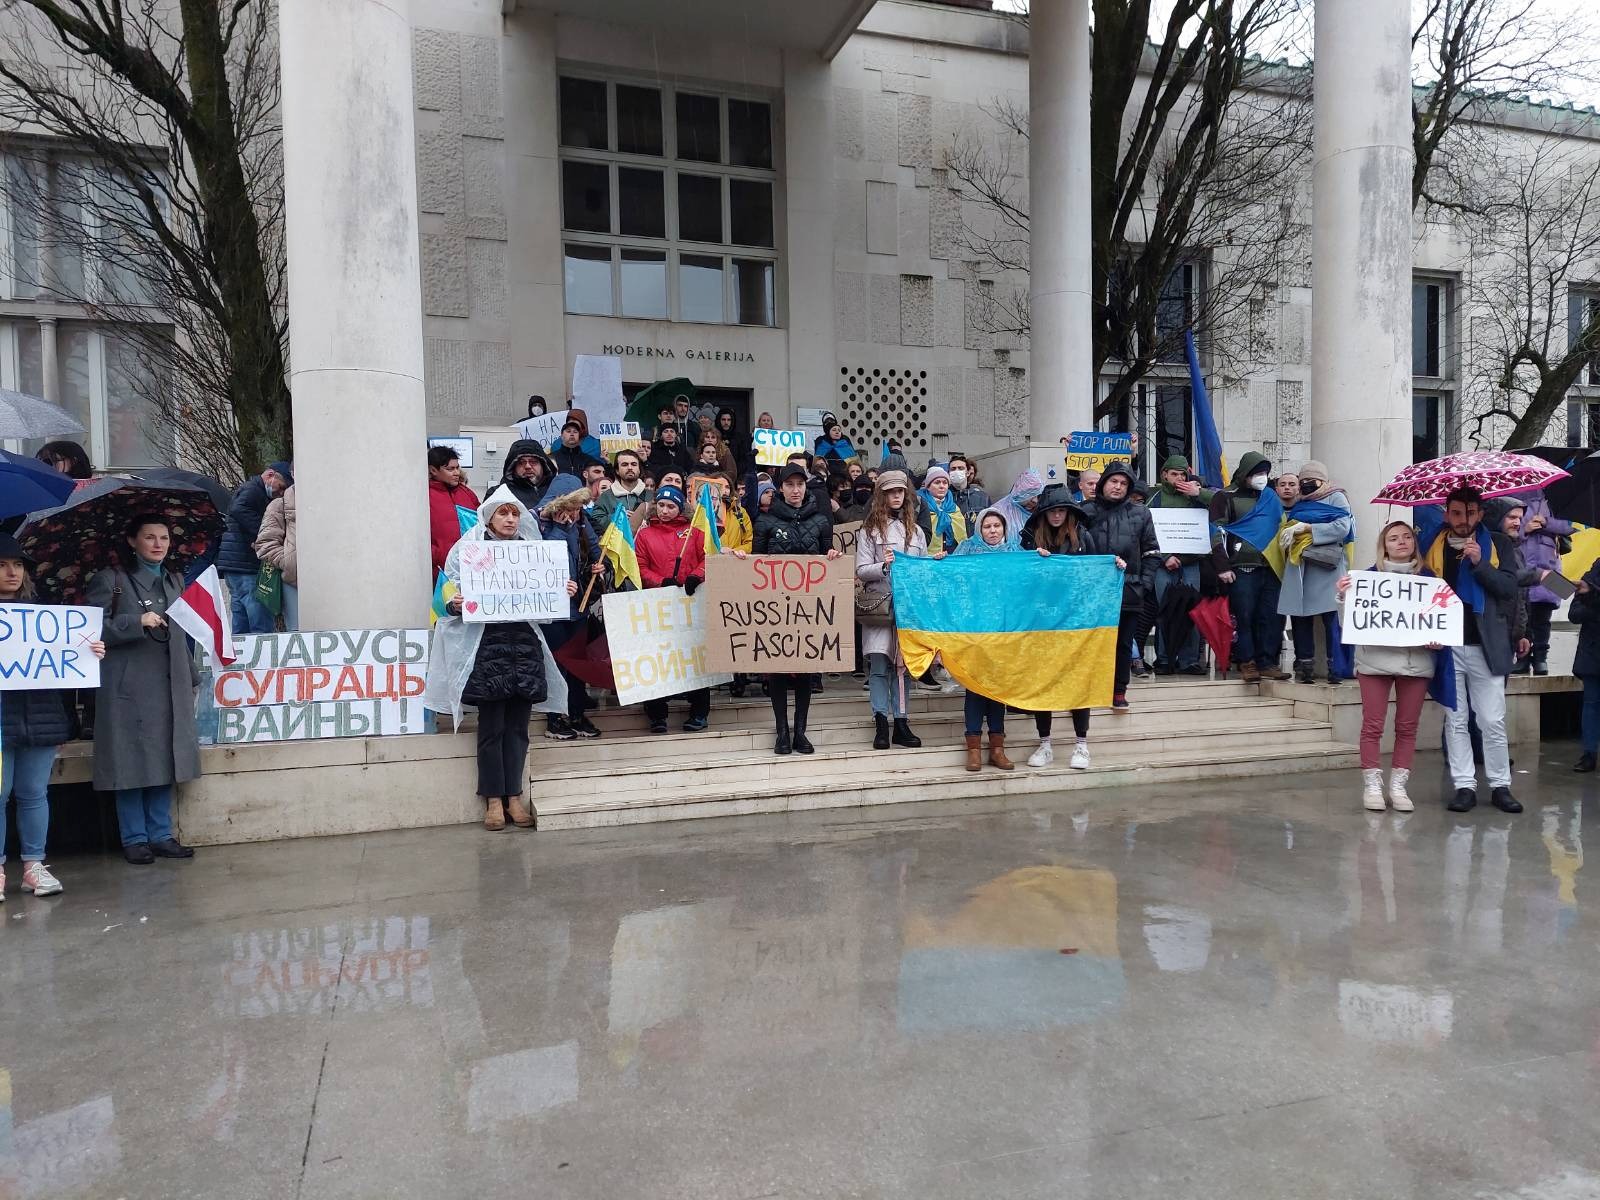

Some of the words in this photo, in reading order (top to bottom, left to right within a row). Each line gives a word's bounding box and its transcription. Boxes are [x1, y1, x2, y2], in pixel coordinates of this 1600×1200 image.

[602, 344, 675, 359] MODERNA
[685, 349, 755, 362] GALERIJA
[599, 423, 622, 435] SAVE
[754, 428, 805, 447] СТОП
[1070, 434, 1100, 449] STOP
[1102, 436, 1132, 451] PUTIN
[1067, 455, 1099, 469] STOP
[493, 545, 555, 565] PUTIN,
[470, 568, 541, 591] HANDS
[545, 568, 568, 589] OFF
[751, 558, 827, 593] STOP
[1355, 579, 1429, 602] FIGHT
[481, 592, 559, 615] UKRAINE
[1354, 598, 1379, 608] FOR
[0, 607, 88, 645] STOP
[628, 596, 696, 635] НЕТ
[1352, 610, 1448, 630] UKRAINE
[0, 648, 86, 679] WAR
[214, 663, 426, 707] СУПРАЦЬ
